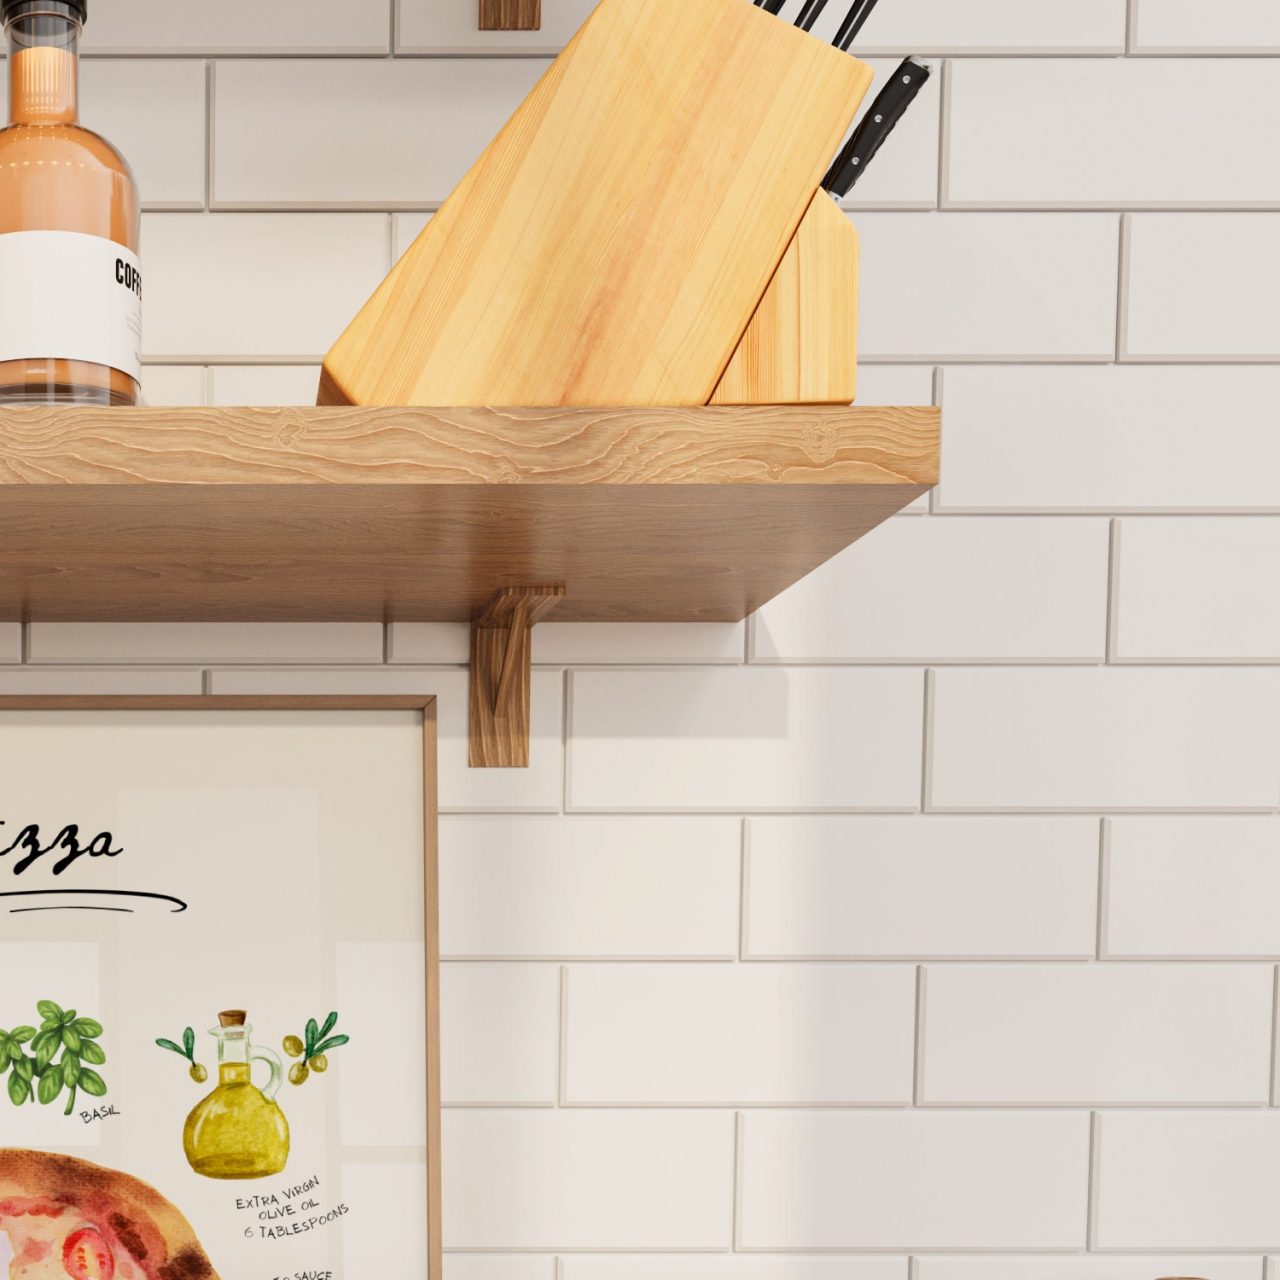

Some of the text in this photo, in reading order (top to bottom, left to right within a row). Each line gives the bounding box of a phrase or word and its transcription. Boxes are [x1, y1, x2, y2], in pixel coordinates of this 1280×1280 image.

[80, 1105, 120, 1123] BASIL
[236, 1175, 320, 1210] EXTRA VIRGIN
[244, 1203, 349, 1239] 6 TABLESPOONS
[259, 1199, 319, 1220] OLIVE OIL
